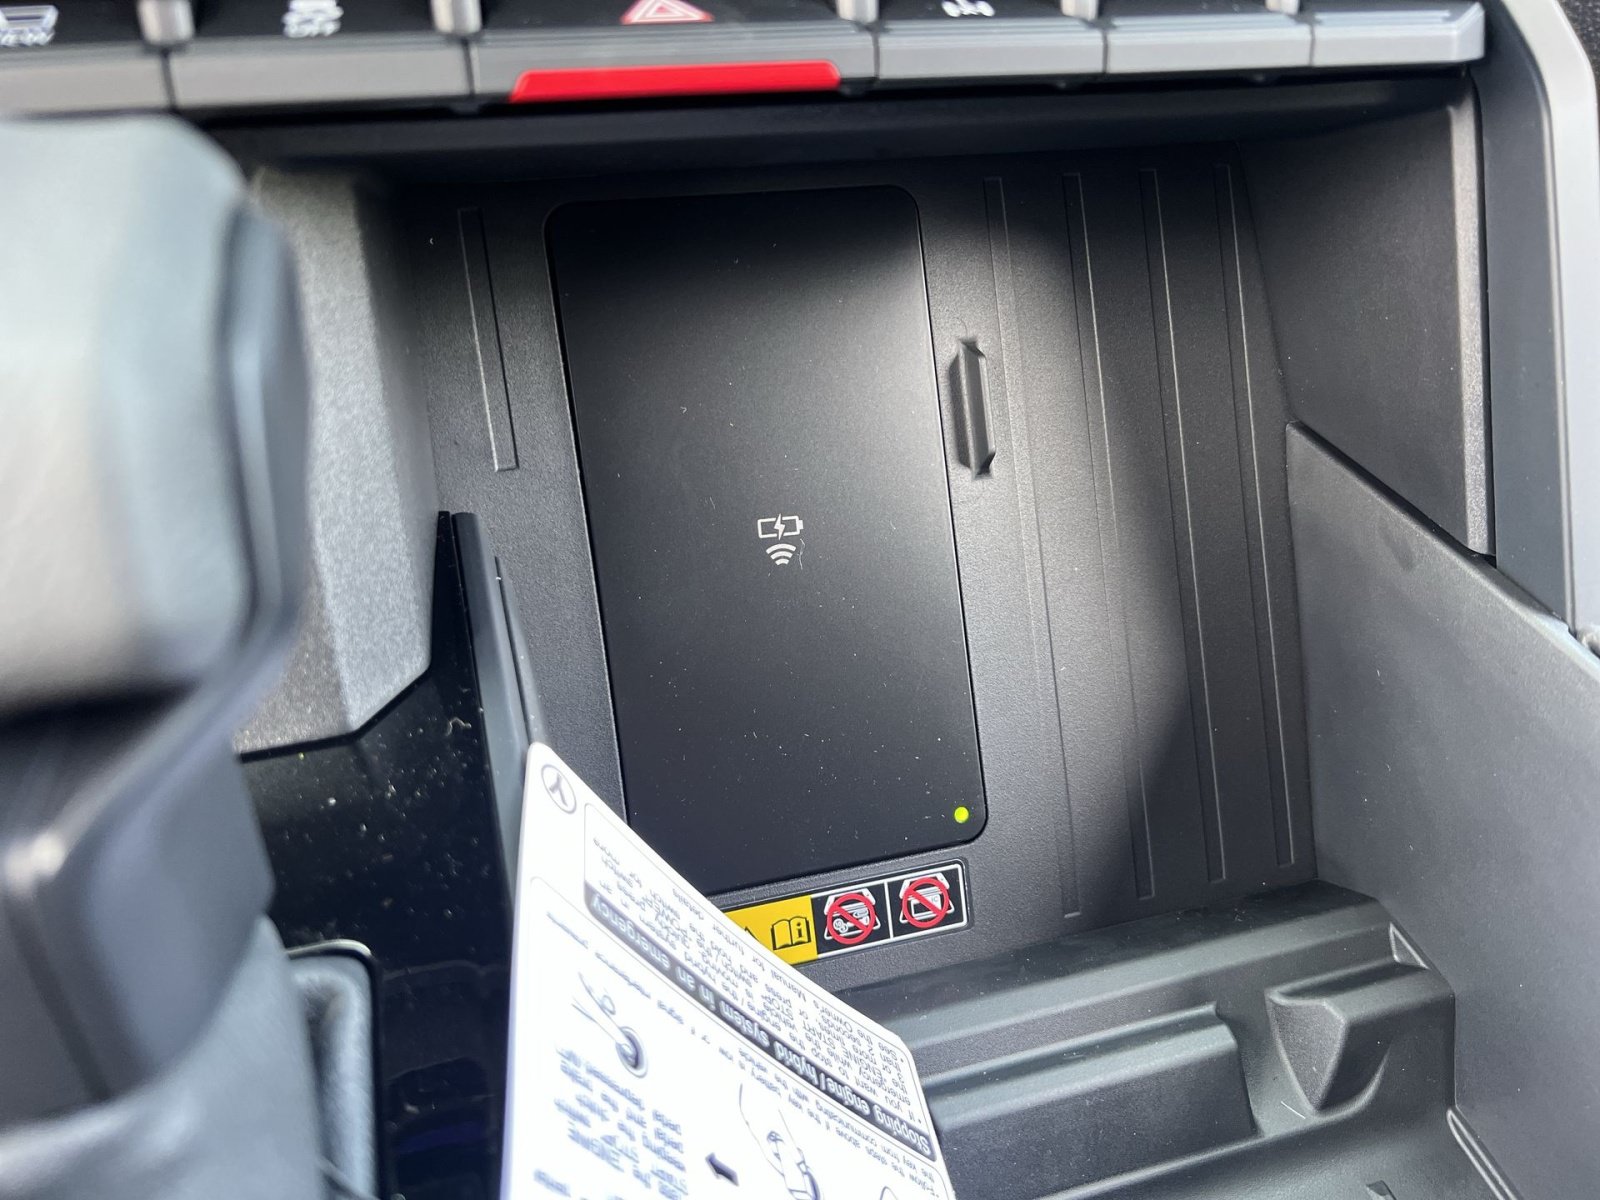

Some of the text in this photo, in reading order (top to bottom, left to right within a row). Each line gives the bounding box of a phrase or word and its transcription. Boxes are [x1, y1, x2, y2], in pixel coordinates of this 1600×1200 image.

[591, 889, 669, 972] emergency
[675, 963, 695, 993] an
[770, 969, 806, 1003] Manual
[698, 981, 715, 1012] in
[719, 998, 770, 1050] system
[802, 1020, 835, 1050] START
[811, 1046, 832, 1069] stop
[852, 1043, 876, 1065] more
[877, 1041, 897, 1061] See
[879, 1052, 901, 1073] than
[854, 1075, 877, 1097] want
[873, 1102, 931, 1158] Stopping
